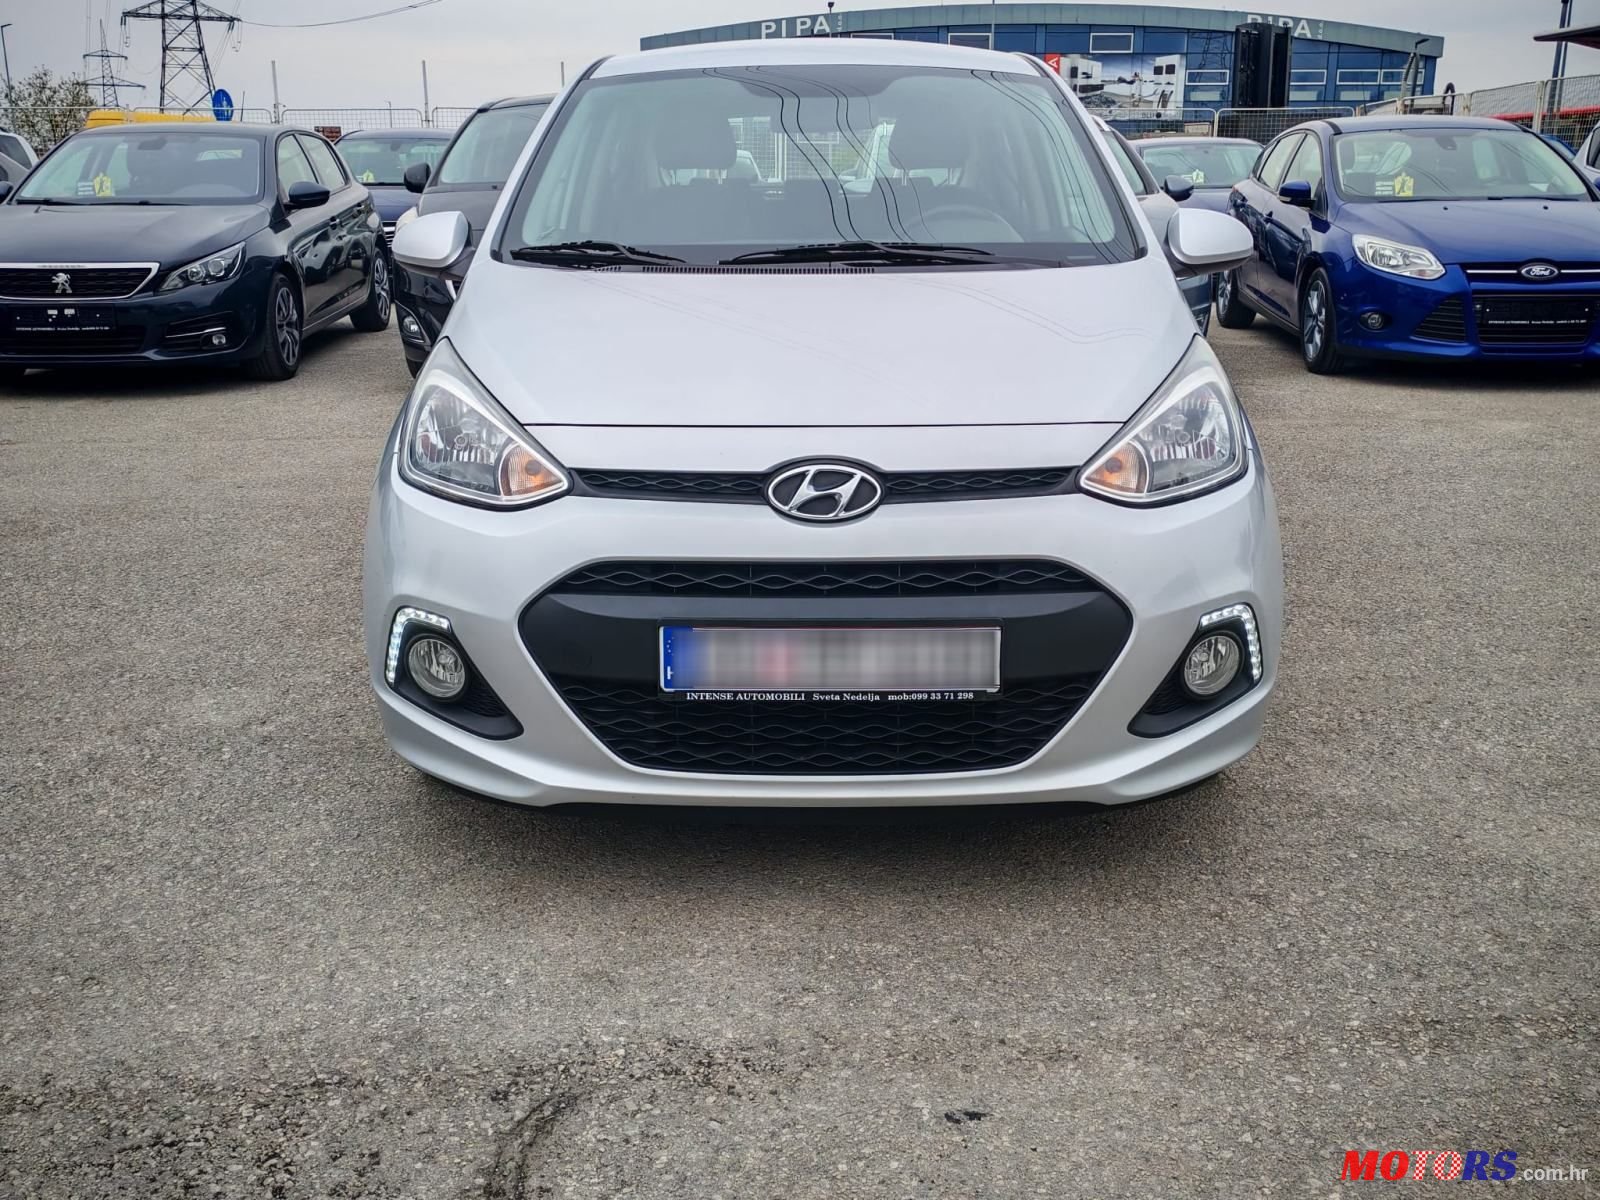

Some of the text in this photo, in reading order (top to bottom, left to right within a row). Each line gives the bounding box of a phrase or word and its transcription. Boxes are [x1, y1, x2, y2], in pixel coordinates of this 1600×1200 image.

[761, 16, 830, 39] PIPA
[1530, 266, 1550, 276] Ford
[686, 692, 733, 700] INTENSE
[736, 692, 805, 701] AUTOMOBILI
[843, 692, 880, 702] Nedelja
[888, 692, 928, 700] mob:099
[930, 692, 941, 700] 33
[944, 692, 954, 700] 71
